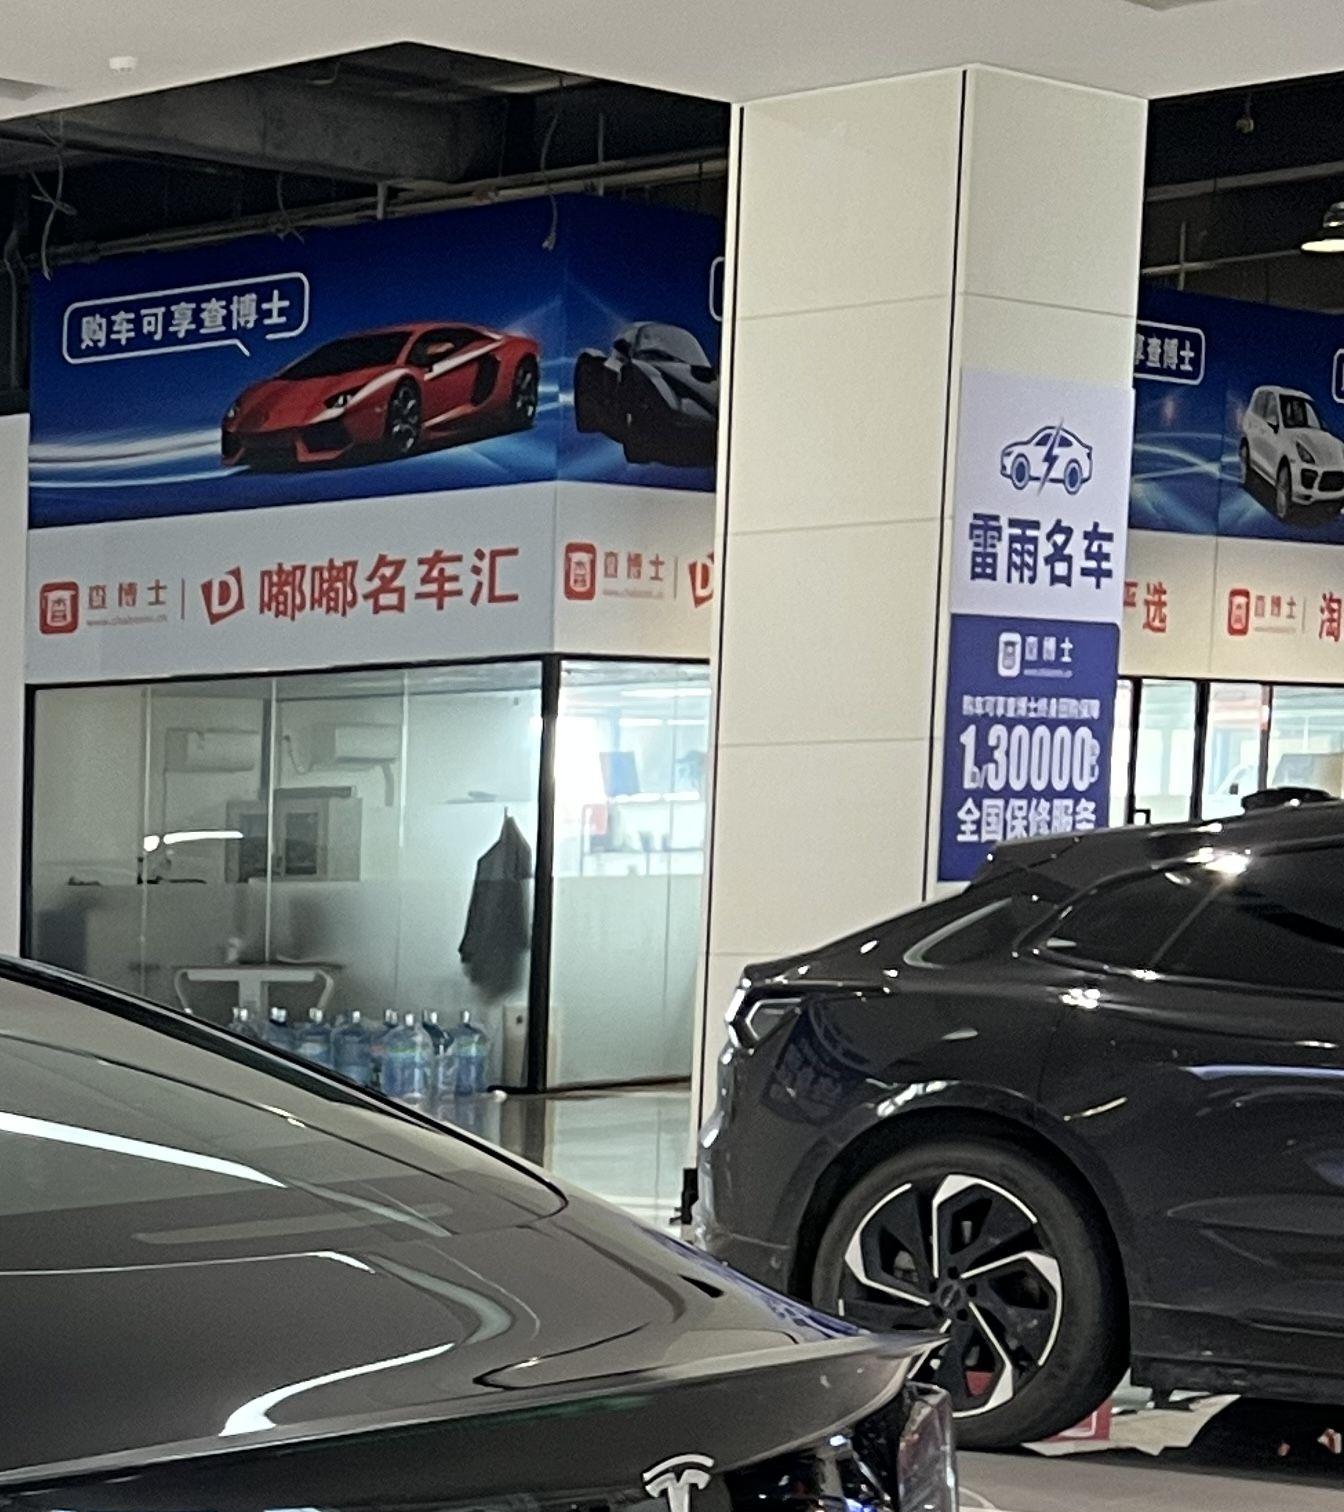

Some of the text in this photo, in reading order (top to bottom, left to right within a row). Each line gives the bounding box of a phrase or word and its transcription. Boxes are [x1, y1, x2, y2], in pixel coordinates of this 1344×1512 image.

[81, 289, 290, 348] 购车可享查博士
[258, 547, 518, 622] 嘟嘟名车汇
[969, 513, 1113, 589] 雷雨名车
[957, 797, 1096, 843] 全国保修服务
